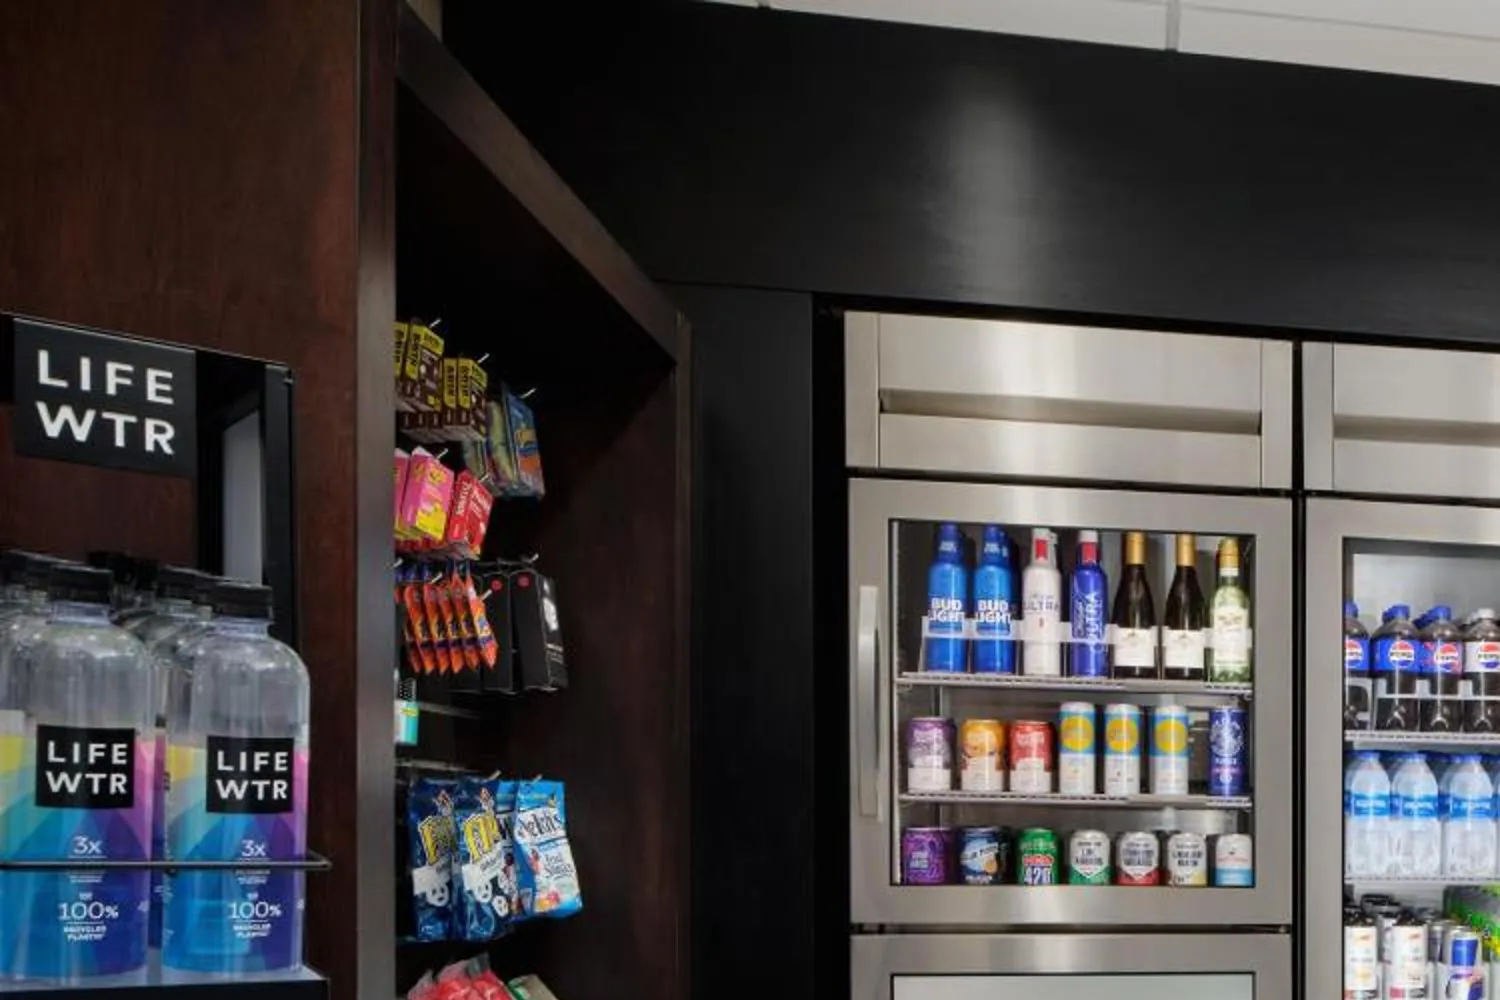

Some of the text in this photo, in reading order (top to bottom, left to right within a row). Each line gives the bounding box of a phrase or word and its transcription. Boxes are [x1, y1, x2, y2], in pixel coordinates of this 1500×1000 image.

[38, 350, 174, 404] LIFE
[35, 401, 175, 454] WTR
[931, 598, 962, 611] BUD
[978, 600, 1009, 612] BUD
[47, 741, 128, 765] LIFE
[217, 751, 289, 772] LIFE
[46, 770, 128, 795] WTR
[215, 779, 288, 800] WTR
[73, 836, 103, 855] 3x
[241, 839, 267, 856] 3x
[58, 901, 120, 920] 100%
[228, 901, 282, 920] 100%
